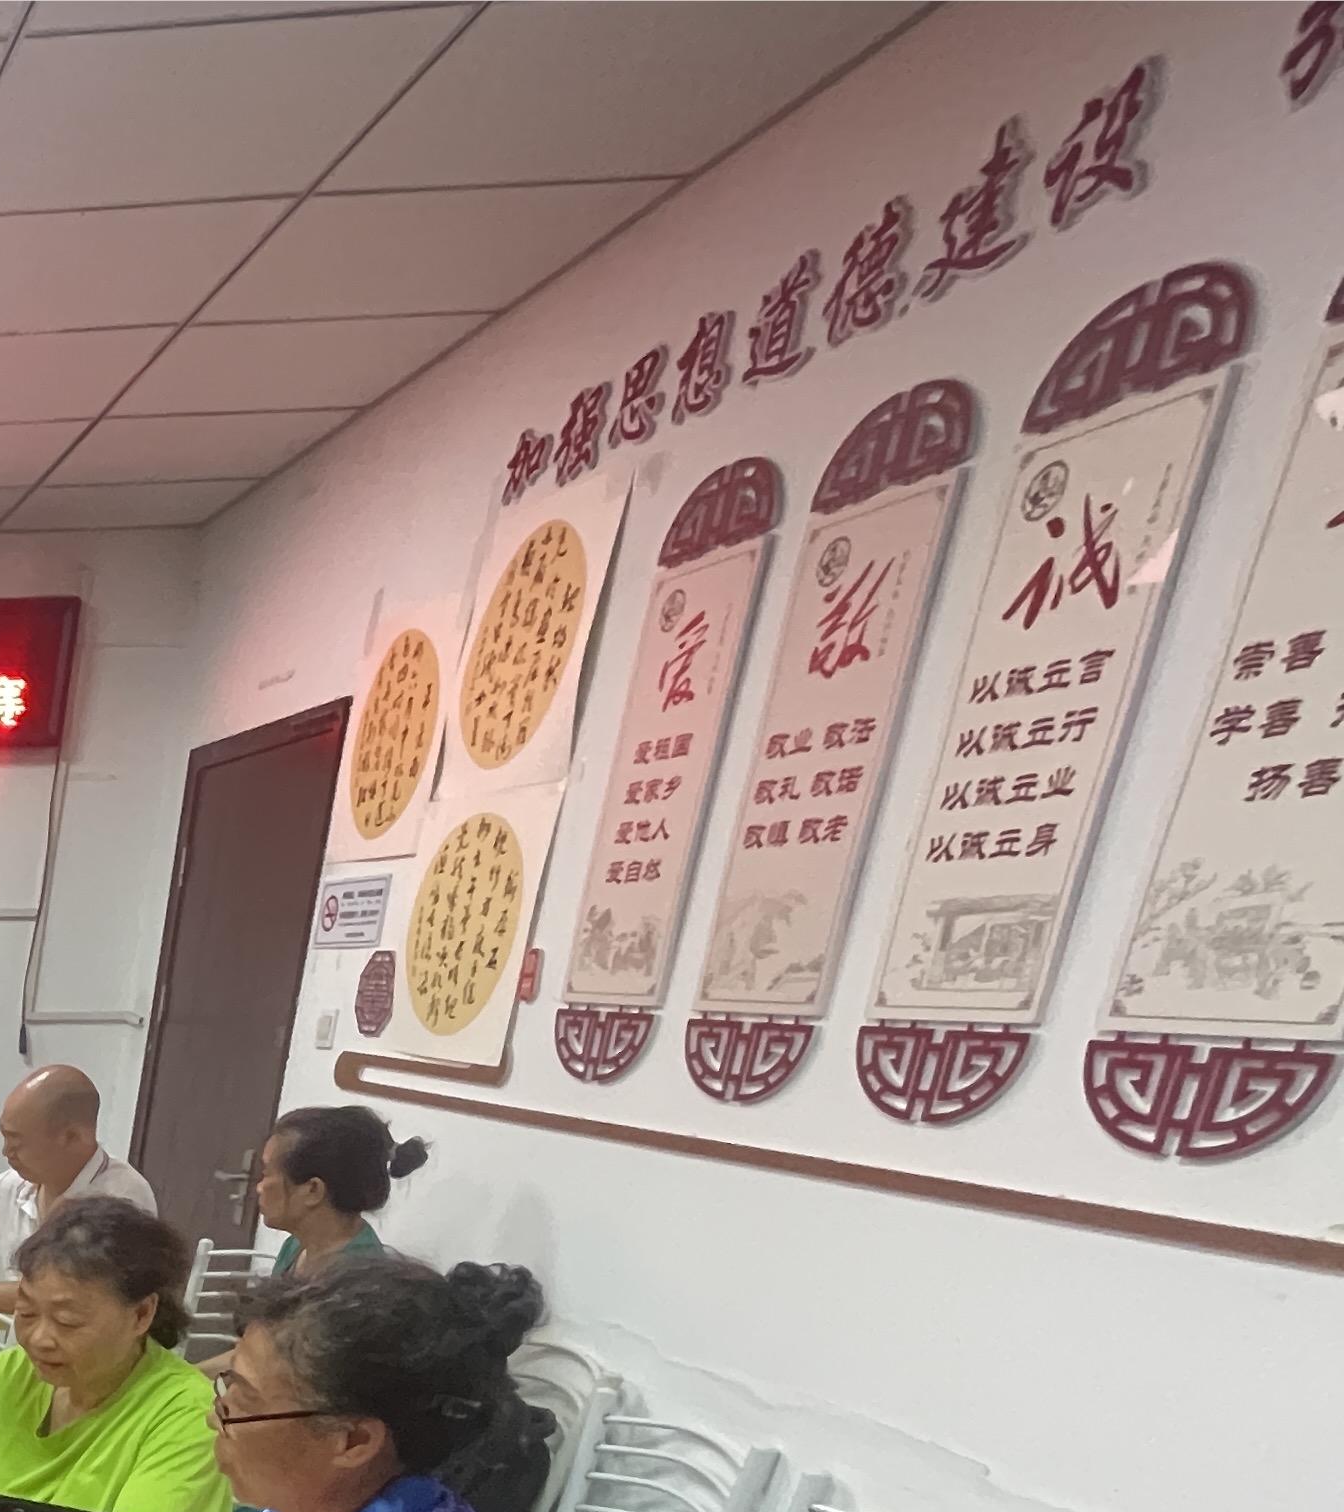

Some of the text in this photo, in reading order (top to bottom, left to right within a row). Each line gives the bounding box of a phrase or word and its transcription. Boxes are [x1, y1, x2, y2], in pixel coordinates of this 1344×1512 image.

[504, 64, 1150, 498] 加强思想道德建设
[1001, 493, 1121, 630] 诚
